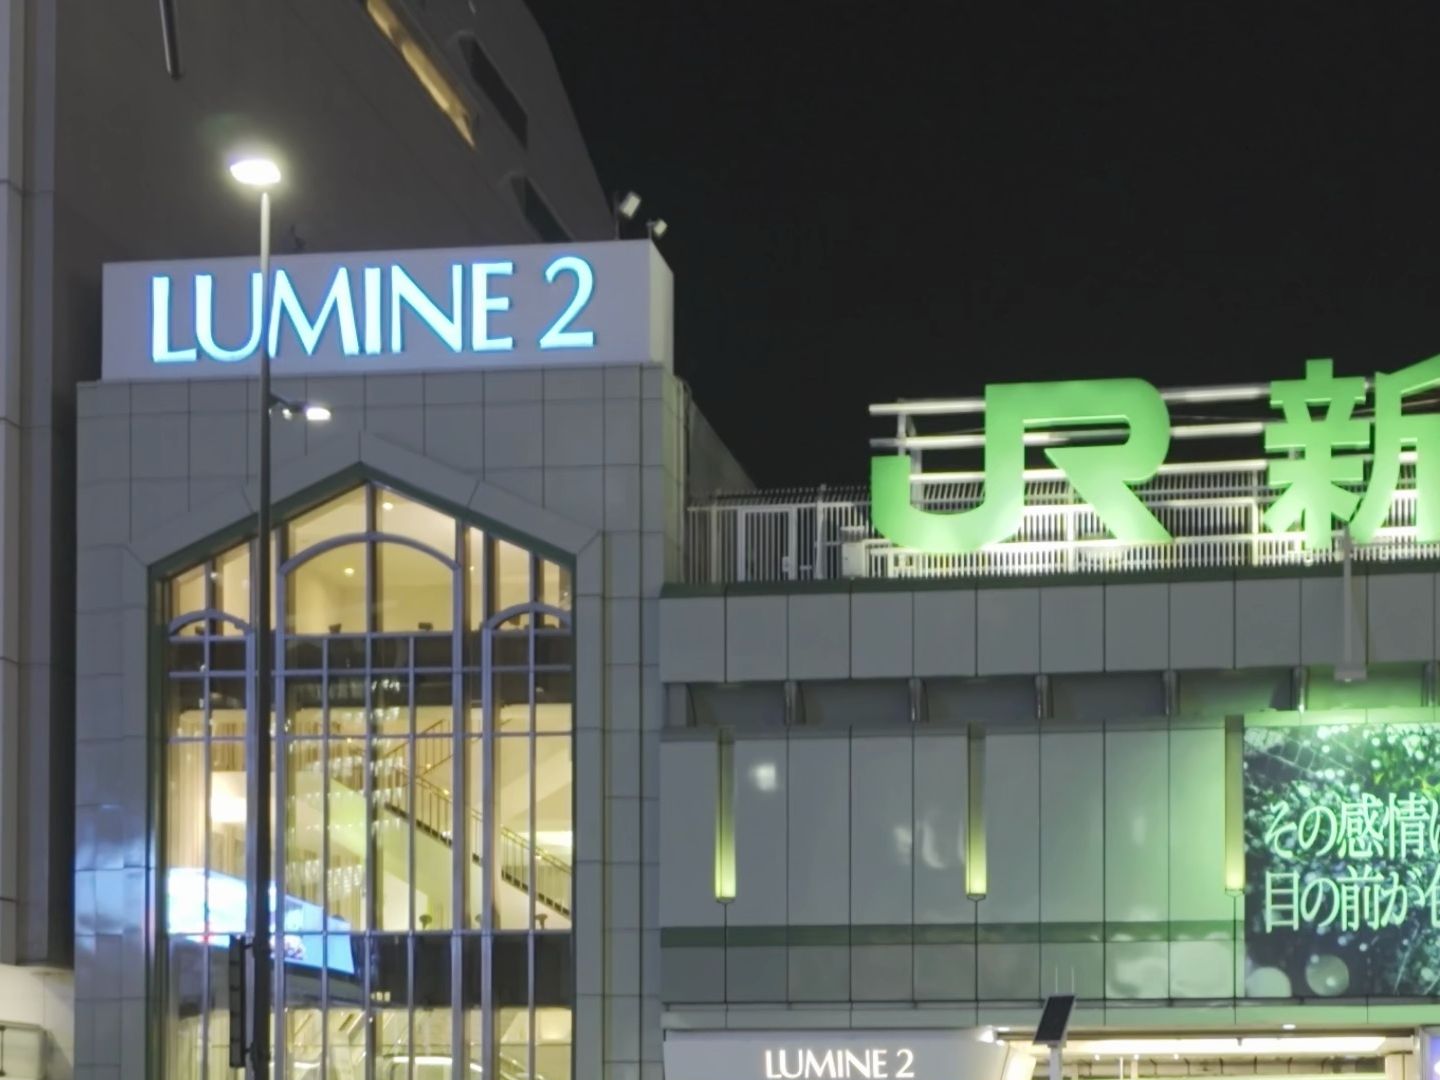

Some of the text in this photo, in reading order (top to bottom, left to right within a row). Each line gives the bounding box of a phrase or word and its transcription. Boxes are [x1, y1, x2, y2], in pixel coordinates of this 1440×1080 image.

[151, 256, 596, 363] LUMINE 2
[764, 1048, 916, 1079] LUMINE 2
